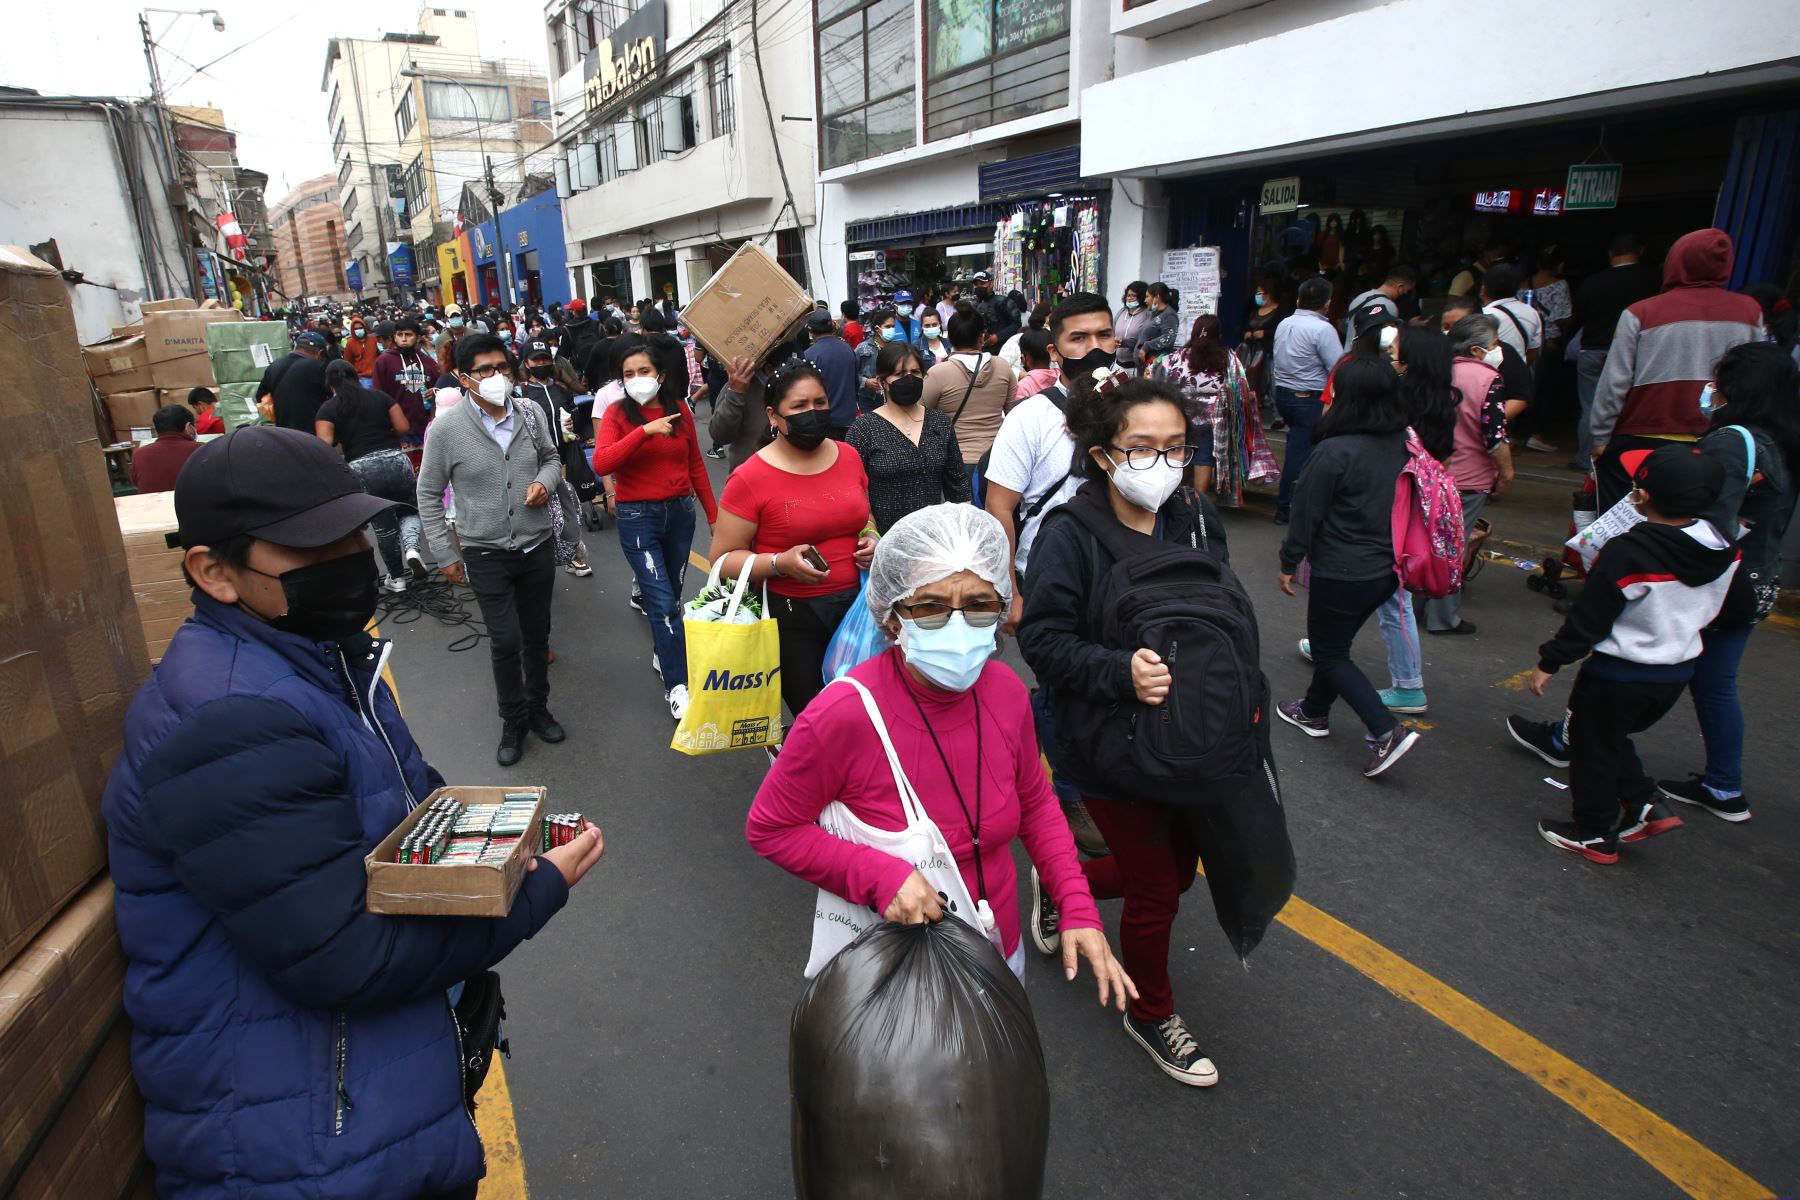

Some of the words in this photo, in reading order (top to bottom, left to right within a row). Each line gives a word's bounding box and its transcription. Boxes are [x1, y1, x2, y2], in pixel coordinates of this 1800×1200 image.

[1264, 185, 1296, 206] SALIDA
[1568, 171, 1616, 203] ENTRADA
[165, 337, 205, 345] D'MARITA
[702, 670, 763, 691] Mass
